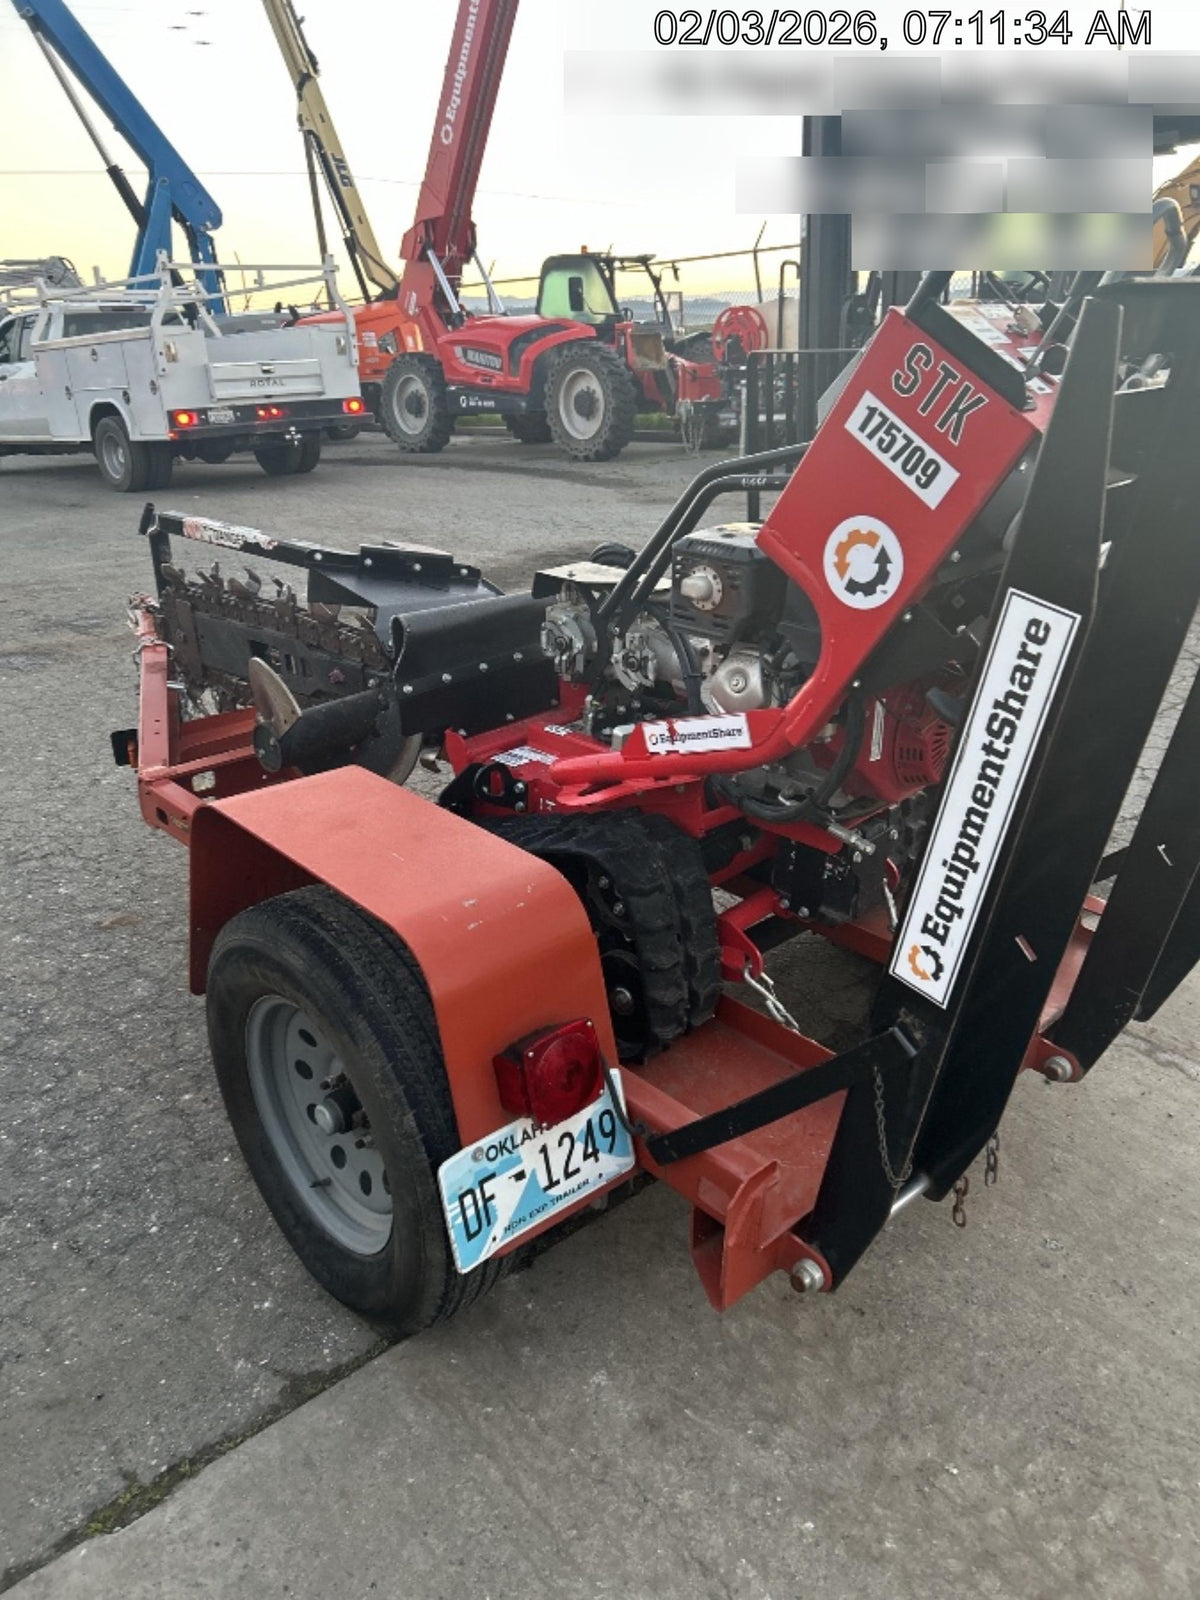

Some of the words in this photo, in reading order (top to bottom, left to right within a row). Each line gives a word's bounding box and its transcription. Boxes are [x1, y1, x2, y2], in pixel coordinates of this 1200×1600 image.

[330, 152, 354, 188] JLG
[249, 378, 286, 388] ROYAL
[891, 342, 990, 446] STK
[857, 404, 942, 490] 175709
[920, 617, 1052, 947] EquipmentShare
[458, 1171, 498, 1243] DF
[538, 1108, 616, 1193] 1249
[550, 1178, 590, 1206] TRAILER
